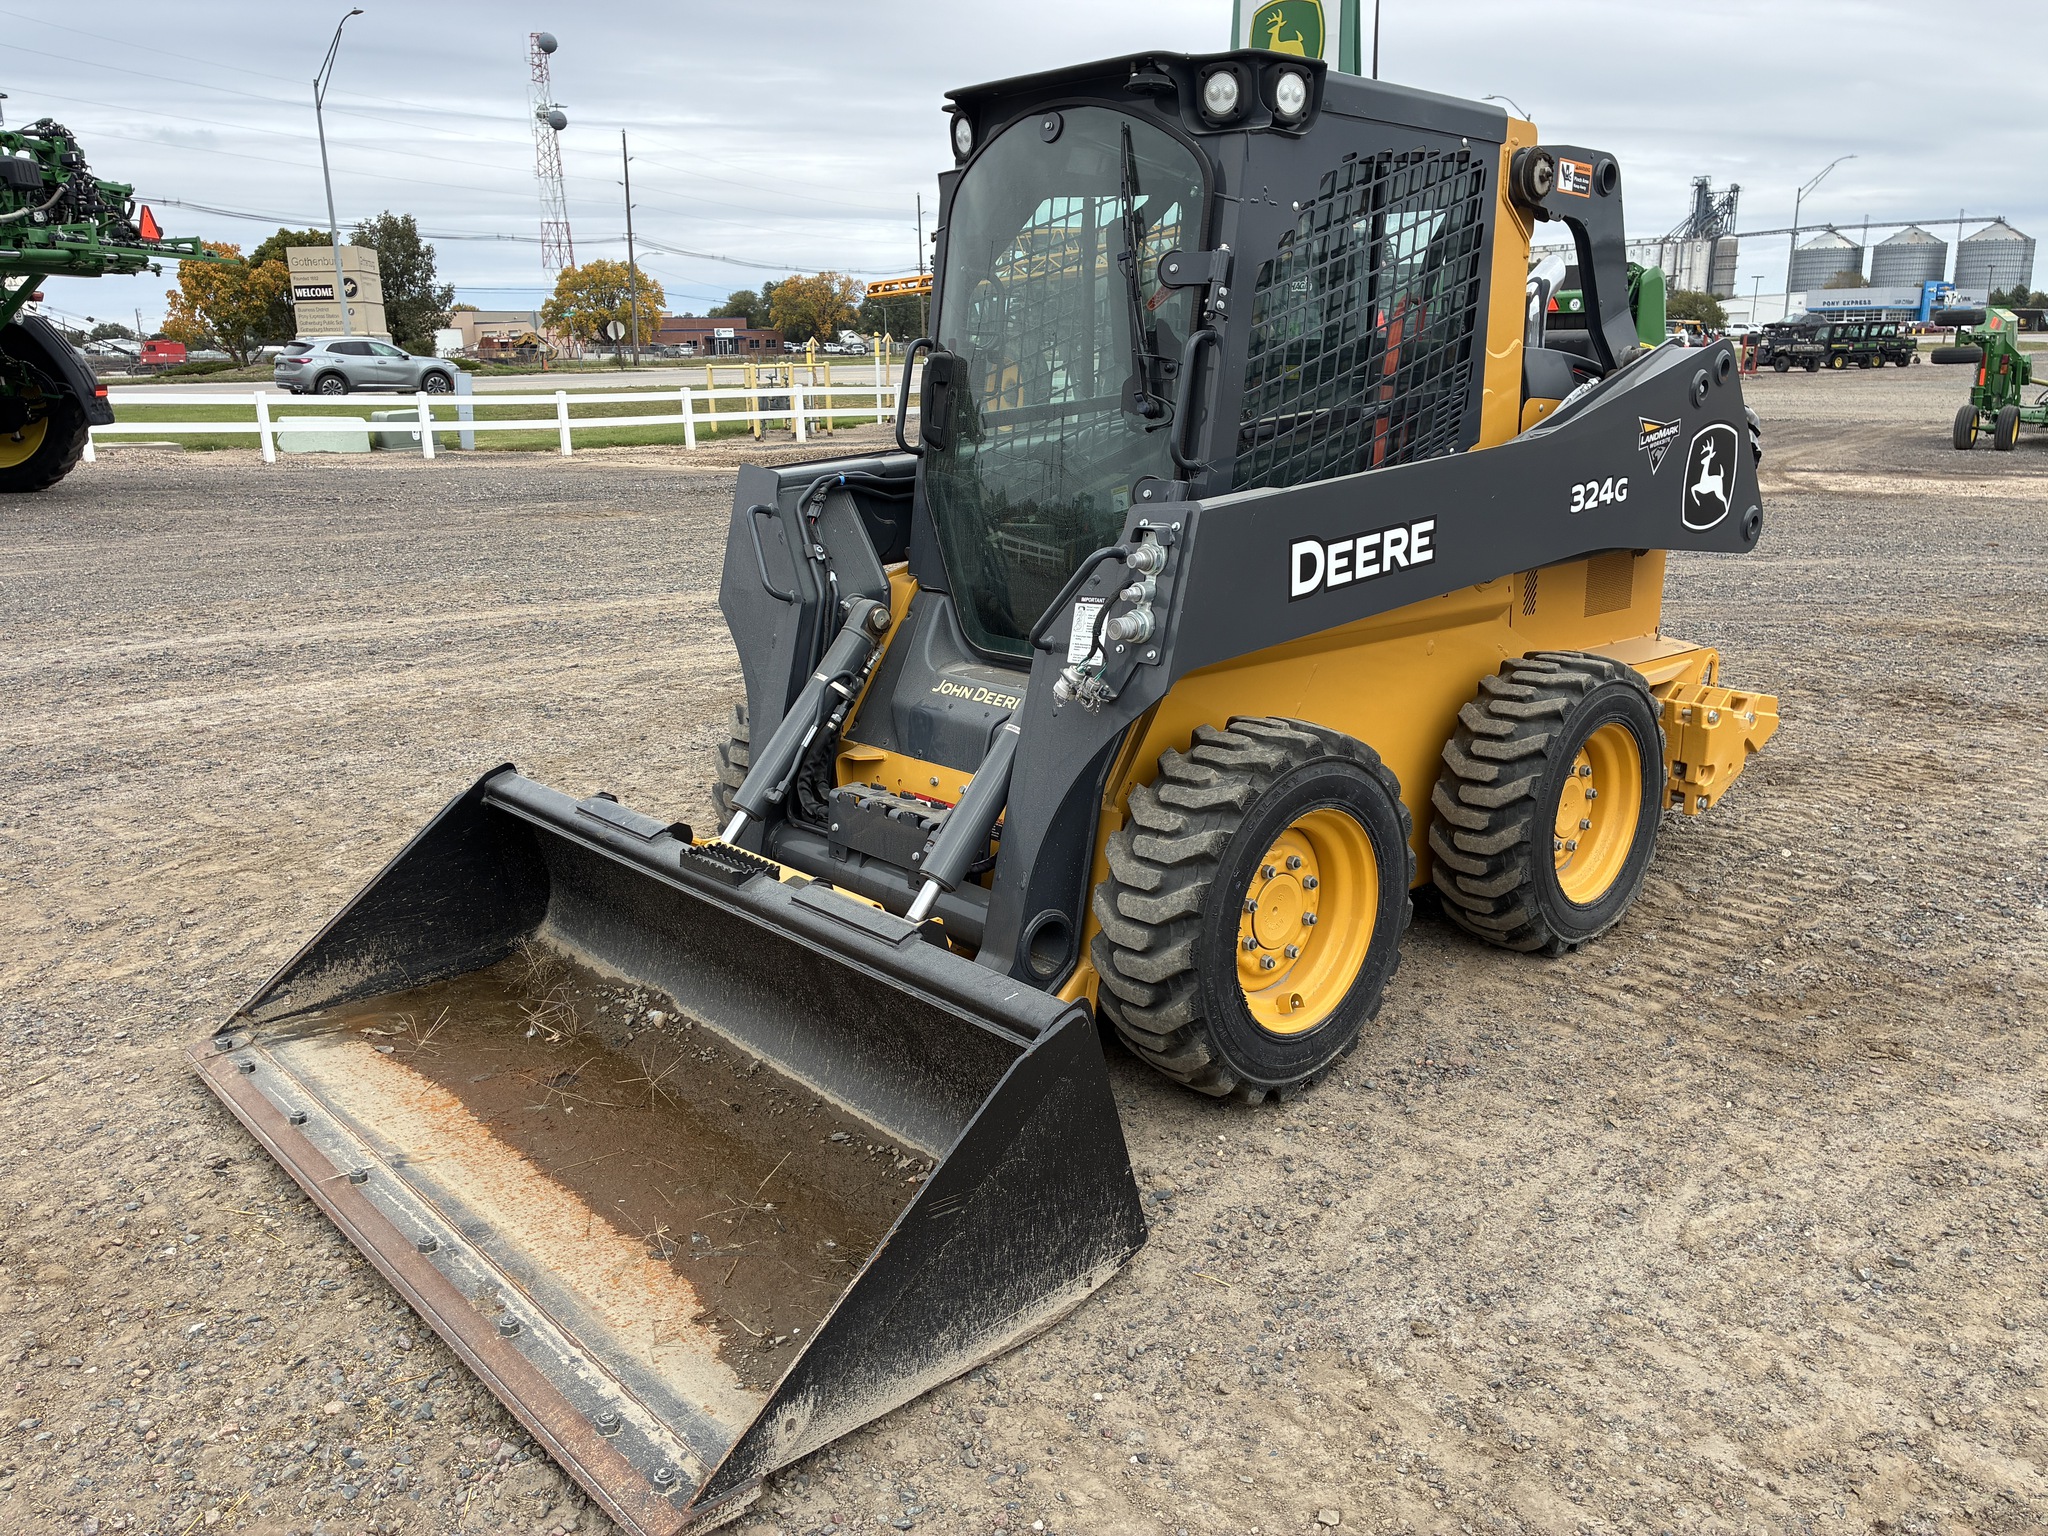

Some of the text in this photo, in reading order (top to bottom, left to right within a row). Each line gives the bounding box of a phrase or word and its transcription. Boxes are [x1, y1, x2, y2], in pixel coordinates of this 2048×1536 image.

[291, 257, 344, 269] Gothenbu
[294, 287, 333, 298] WELCOME
[1641, 425, 1679, 445] LANDMARK
[1649, 437, 1671, 448] WORKSITE
[1570, 477, 1629, 513] 324G
[1291, 519, 1435, 597] DEERE
[931, 679, 1021, 710] JOHN DEER
